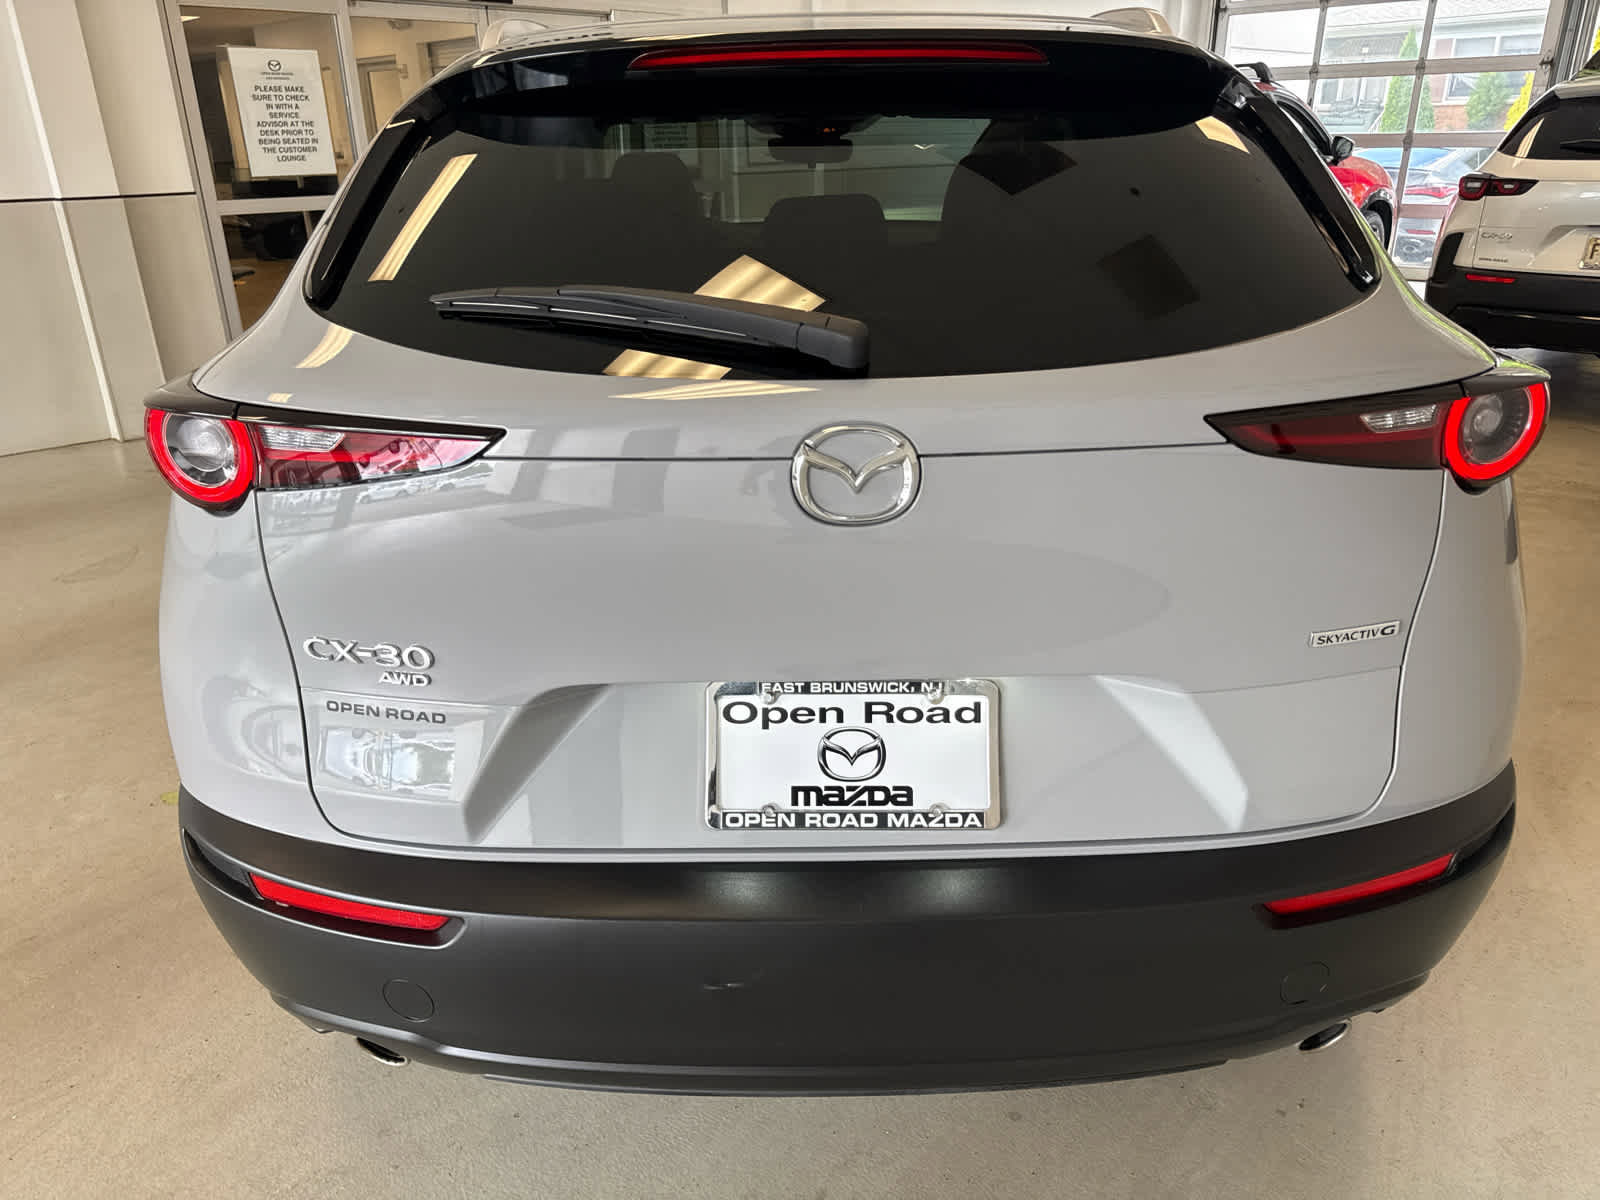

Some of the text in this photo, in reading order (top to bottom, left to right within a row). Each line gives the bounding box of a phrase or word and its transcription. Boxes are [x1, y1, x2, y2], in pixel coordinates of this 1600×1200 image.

[268, 111, 299, 119] SERVICE
[257, 120, 288, 128] ADVISOR
[303, 636, 435, 670] CX-30
[378, 671, 432, 686] AWD
[761, 682, 805, 693] EAST
[810, 681, 915, 693] BRUNSWICK,
[326, 700, 447, 724] OPEN ROAD
[722, 701, 982, 730] Open Road
[725, 813, 983, 828] OPEN ROAD MAZDA
